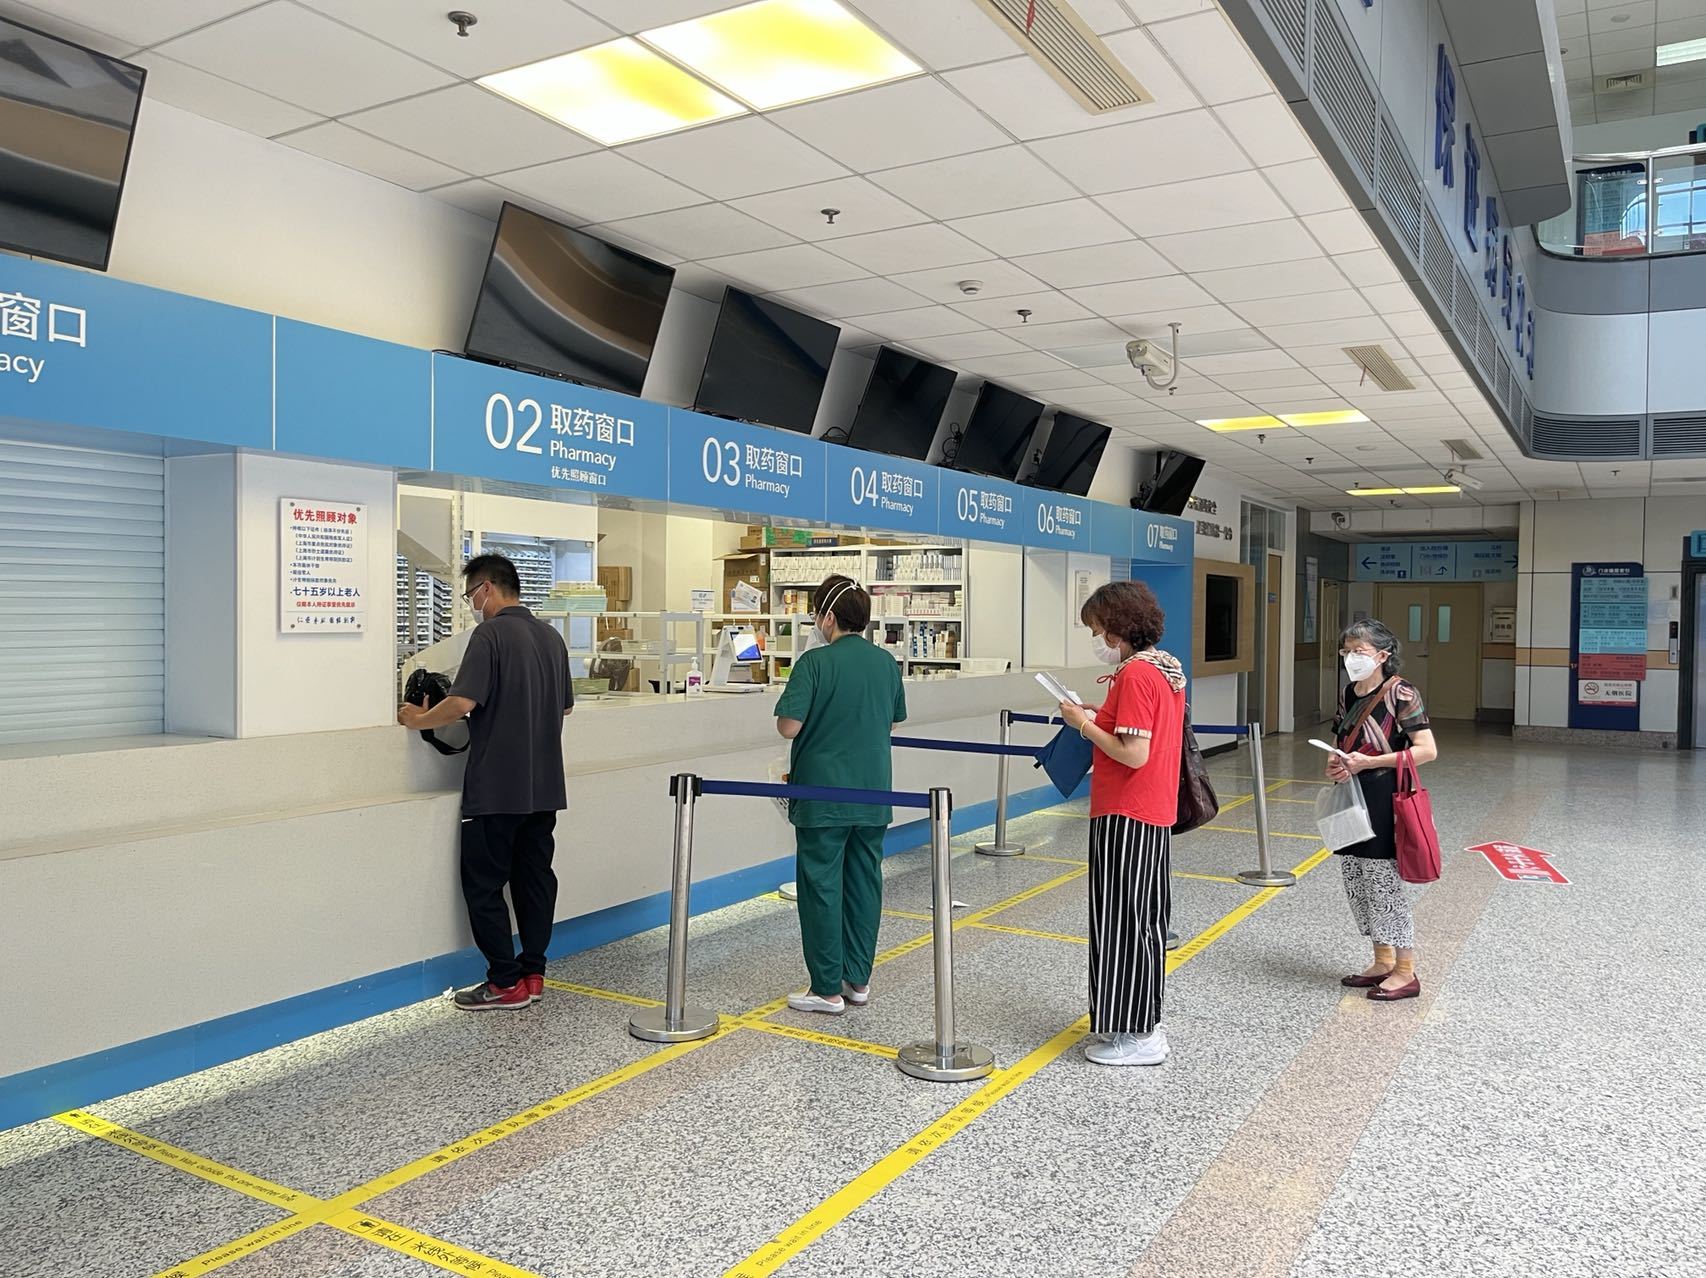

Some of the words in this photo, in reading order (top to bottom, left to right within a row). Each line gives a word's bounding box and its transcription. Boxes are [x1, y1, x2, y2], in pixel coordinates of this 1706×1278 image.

[485, 393, 543, 455] 02
[550, 403, 634, 447] 取药窗口
[550, 440, 616, 471] Pharmacy
[702, 436, 741, 487] 03
[745, 444, 803, 478] 取药窗口
[551, 466, 607, 486] 优先照顾窗口
[745, 474, 790, 499] Pharmacy
[851, 466, 879, 507] 04
[881, 471, 923, 499] 取药窗口
[293, 508, 357, 525] 优先照顾对象
[881, 496, 914, 517] Pharmacy
[957, 487, 979, 523] 05
[980, 491, 1012, 513] 取药窗口
[1055, 506, 1082, 526] 取药窗口
[979, 513, 1005, 530] Pharmacy
[1037, 503, 1055, 534] 06
[1055, 525, 1076, 540] Pharmacy
[1146, 523, 1159, 548] 07
[293, 587, 360, 597] 七十五岁以上老人
[201, 1247, 243, 1266] Please
[247, 1235, 268, 1248] wait
[269, 1229, 281, 1237] in
[282, 1220, 303, 1231] line
[372, 1227, 487, 1271] 请在一米线外等候
[755, 1247, 786, 1266] Please
[785, 1234, 800, 1248] wait
[808, 1220, 823, 1231] line
